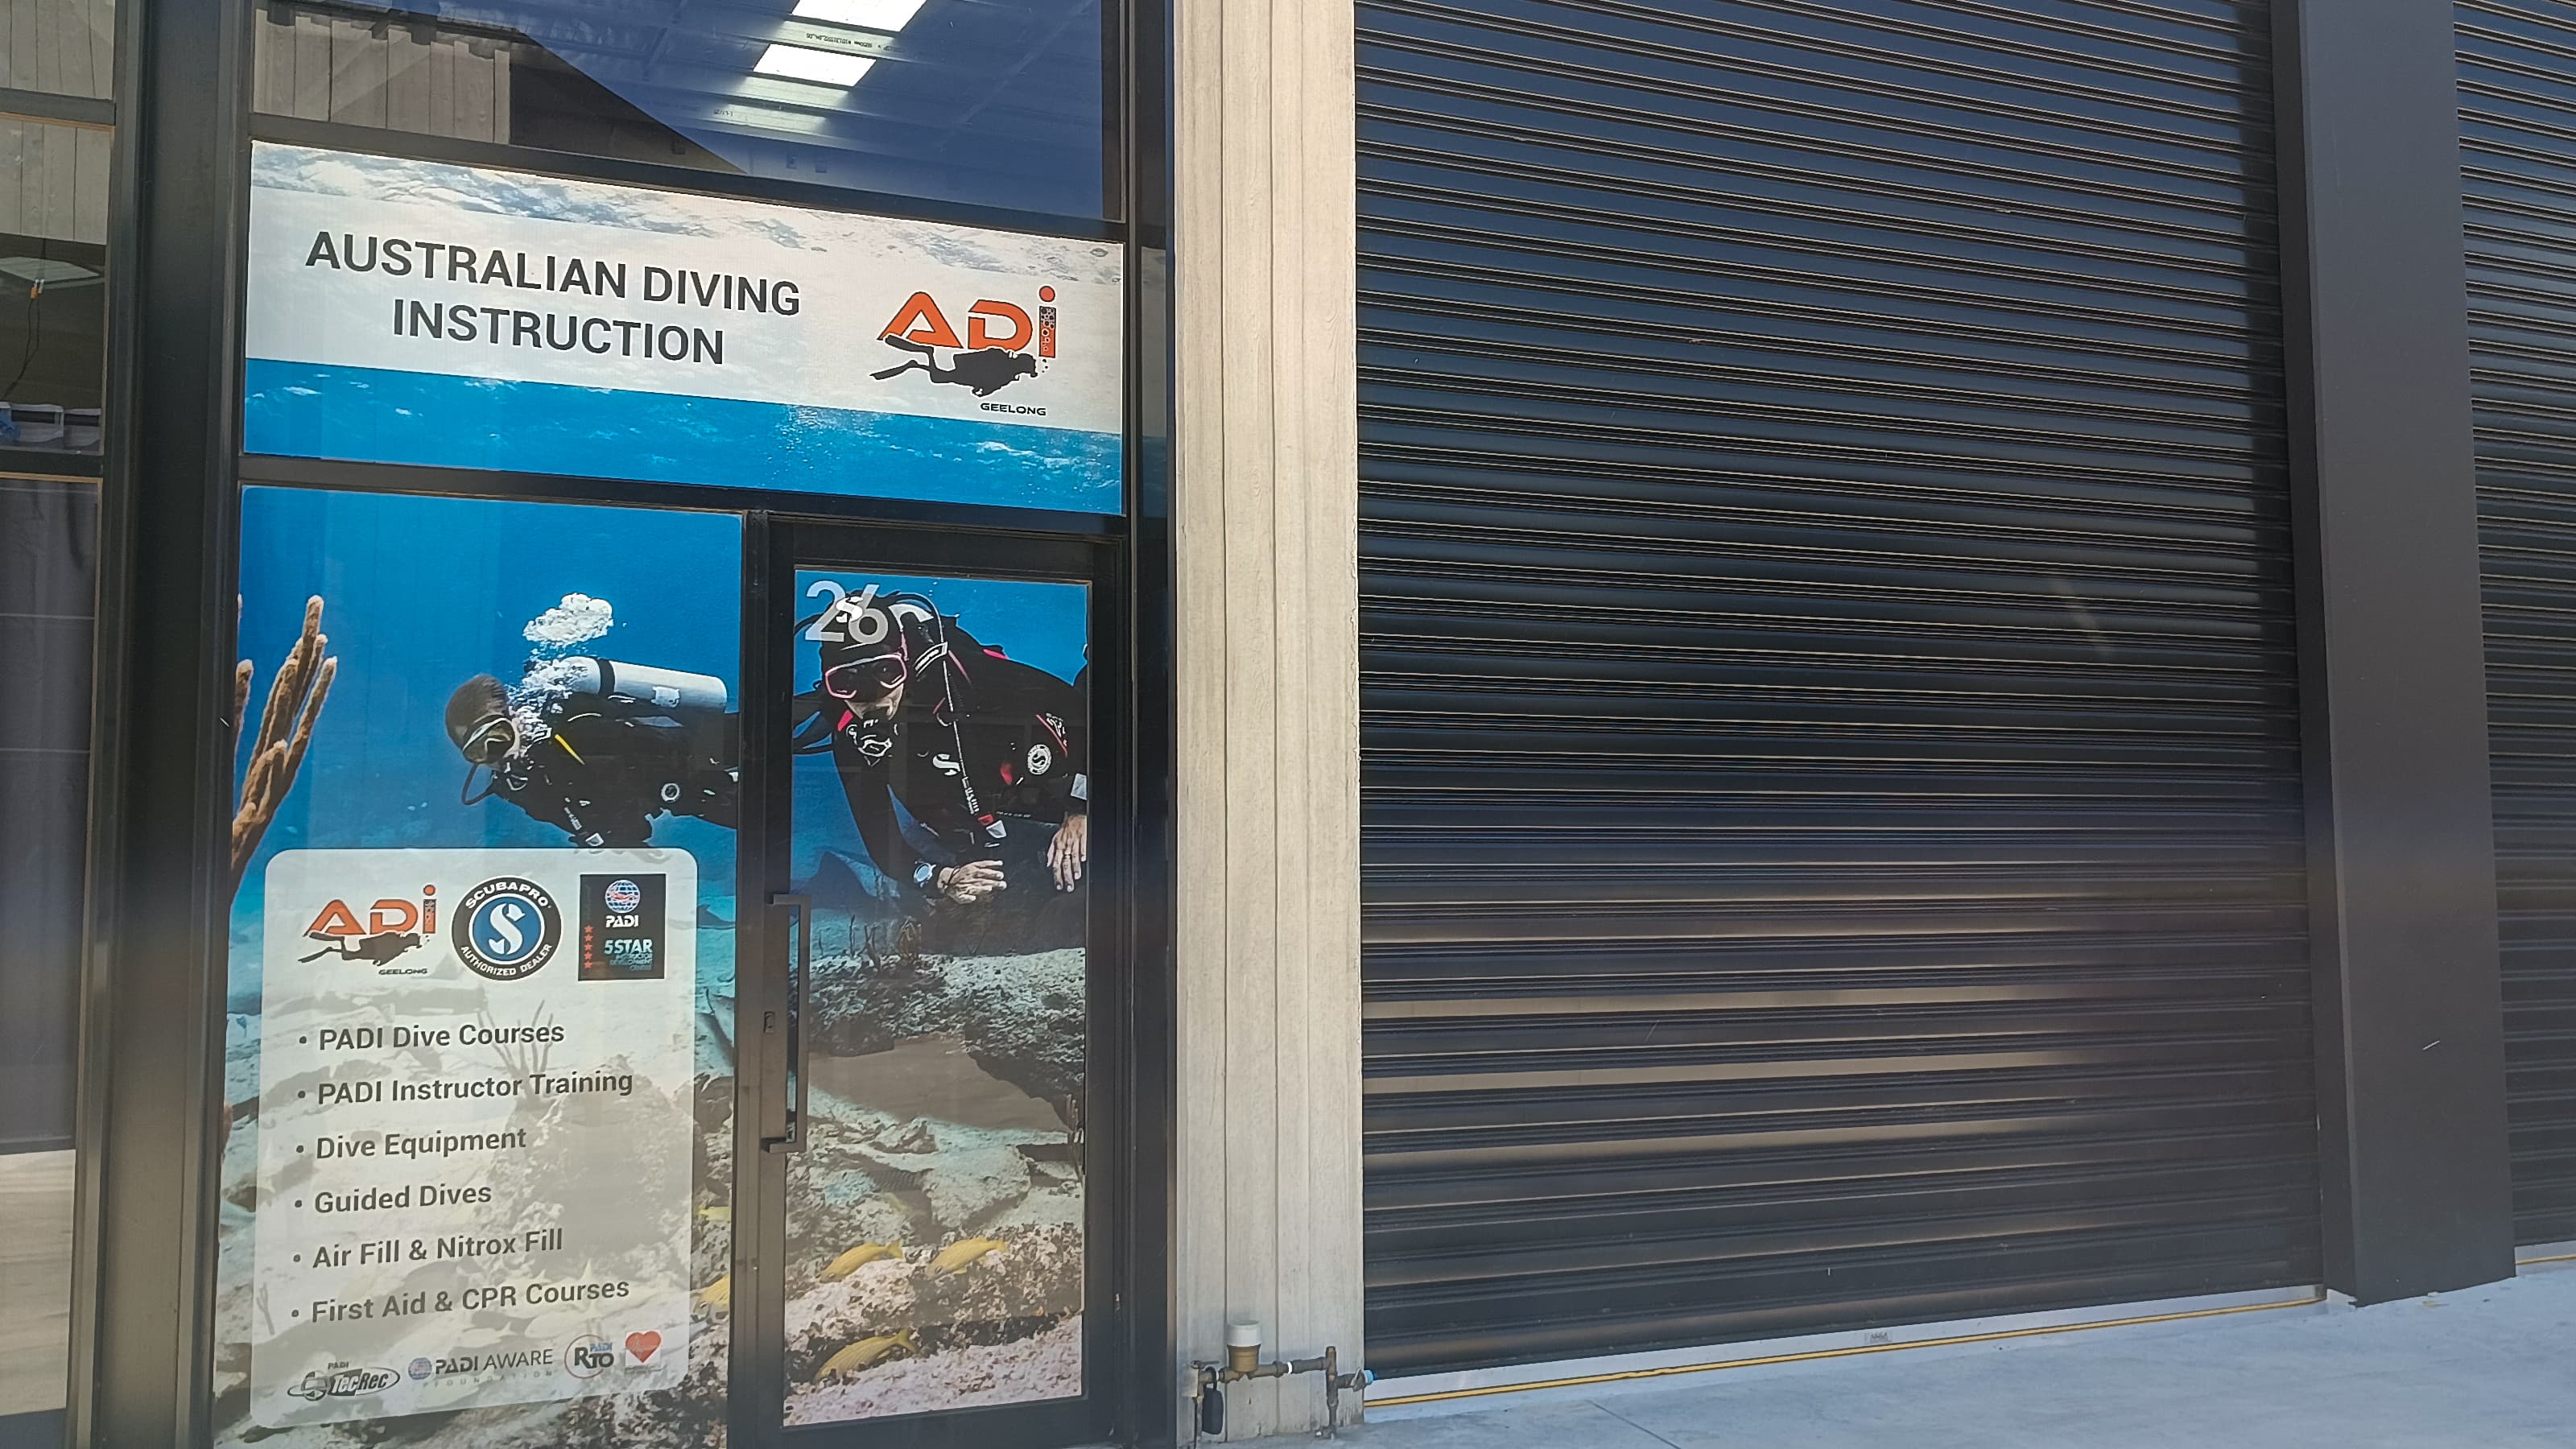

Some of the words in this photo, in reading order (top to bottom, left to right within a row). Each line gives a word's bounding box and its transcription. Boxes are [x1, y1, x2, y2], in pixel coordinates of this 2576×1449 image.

[304, 231, 626, 299] AUSTRALIAN
[643, 266, 800, 316] DIVING
[392, 299, 724, 365] INSTRUCTION
[980, 402, 1047, 416] GEELONG
[805, 580, 889, 645] 26
[465, 881, 549, 909] SCUBAPRO
[605, 914, 639, 928] PADI
[460, 946, 517, 976] AUTHORIZED
[519, 943, 553, 973] DEALER
[320, 1027, 383, 1051] PADI
[393, 1025, 451, 1048] Dive
[459, 1023, 565, 1046] Courses
[318, 1081, 382, 1104] PADI
[392, 1076, 522, 1101] Instructor
[529, 1071, 633, 1096] Training
[316, 1136, 375, 1159] Dive
[385, 1128, 526, 1160] Equipment
[315, 1187, 410, 1213] Guided
[419, 1183, 492, 1207] Dives
[312, 1245, 352, 1269] Air
[360, 1240, 400, 1265] Fill
[409, 1240, 427, 1261] &
[437, 1233, 516, 1259] Nitrox
[525, 1228, 563, 1253] Fill
[312, 1299, 374, 1323] First
[382, 1292, 426, 1318] Aid
[434, 1291, 452, 1312] &
[462, 1286, 517, 1310] CPR
[526, 1281, 630, 1304] Courses
[328, 1361, 349, 1369] PADI
[436, 1356, 478, 1375] PADI
[482, 1348, 554, 1371] AWARE
[331, 1372, 389, 1393] TecRec
